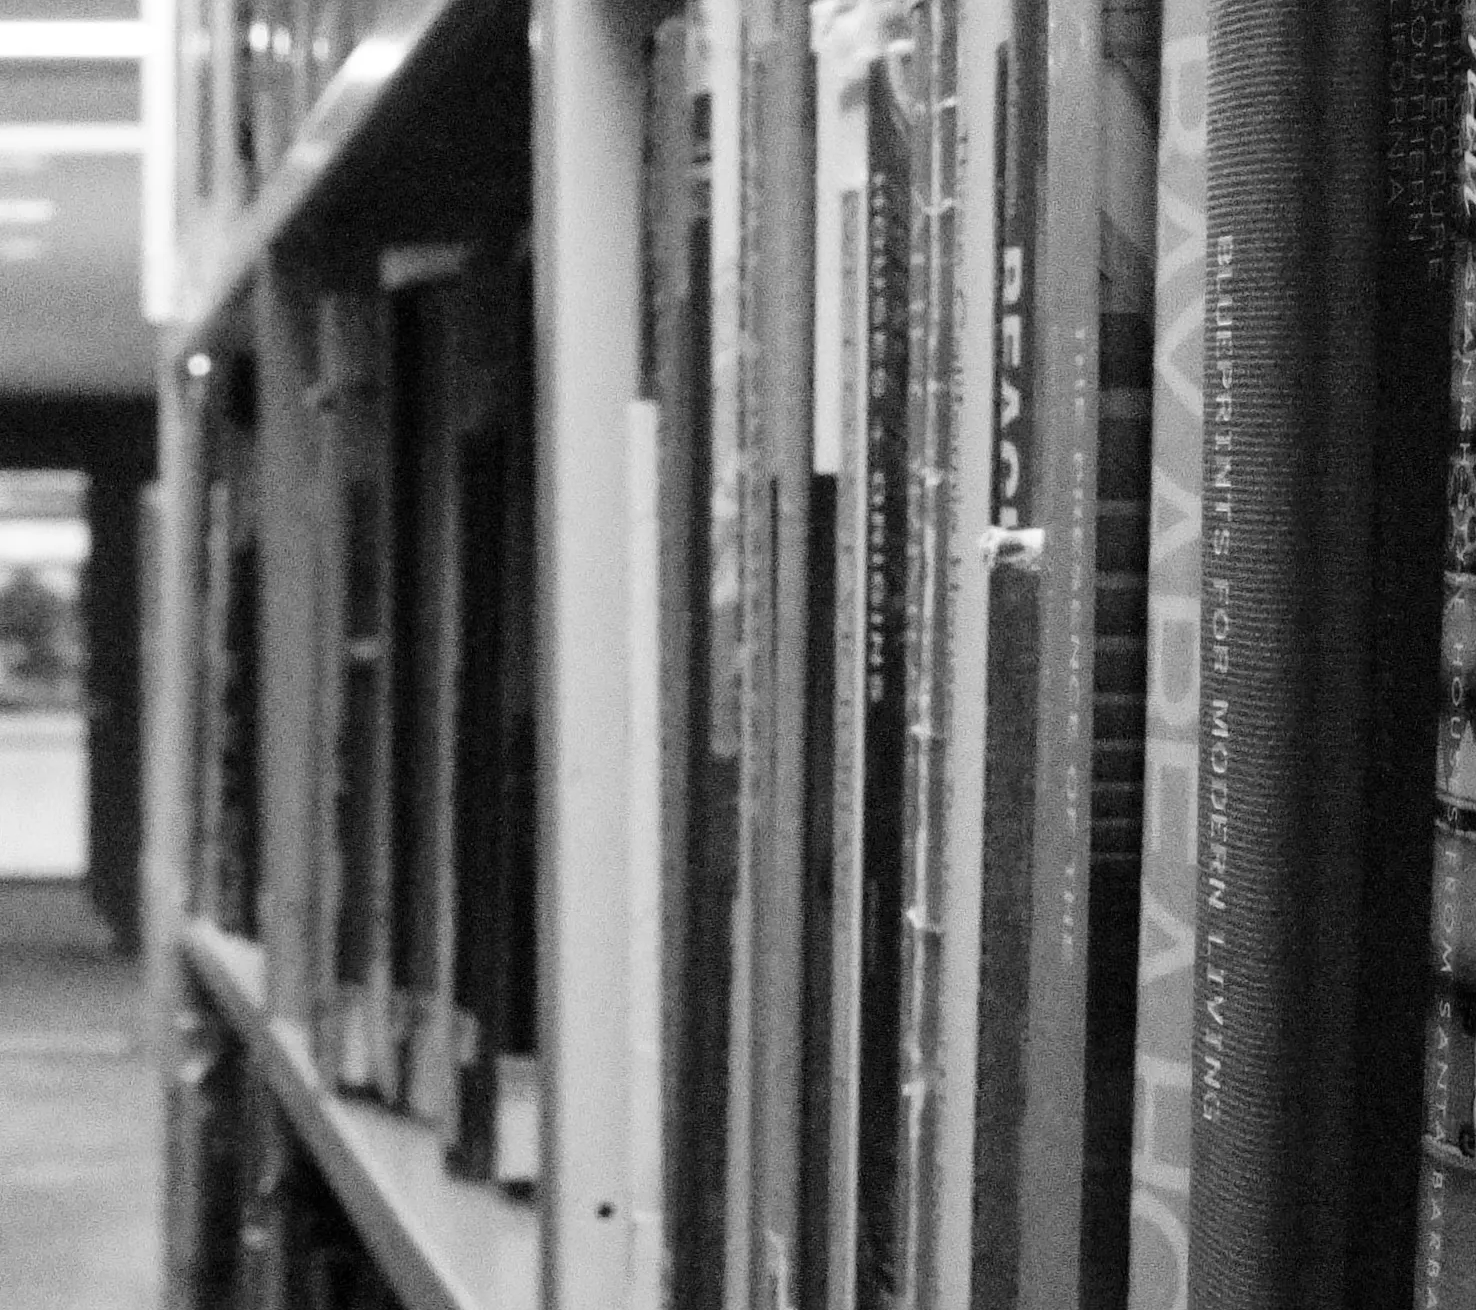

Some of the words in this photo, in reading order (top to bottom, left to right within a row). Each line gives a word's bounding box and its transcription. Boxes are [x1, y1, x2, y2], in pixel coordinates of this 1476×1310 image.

[1155, 34, 1209, 427] BAY
[1211, 232, 1237, 558] BLUEPRINTS
[1138, 461, 1203, 992] AREA
[1208, 576, 1232, 675] FOR
[1205, 696, 1231, 912] MODERN
[1439, 847, 1459, 978] FROM
[1200, 929, 1226, 1125] LIVING
[1434, 999, 1453, 1145] SANTA
